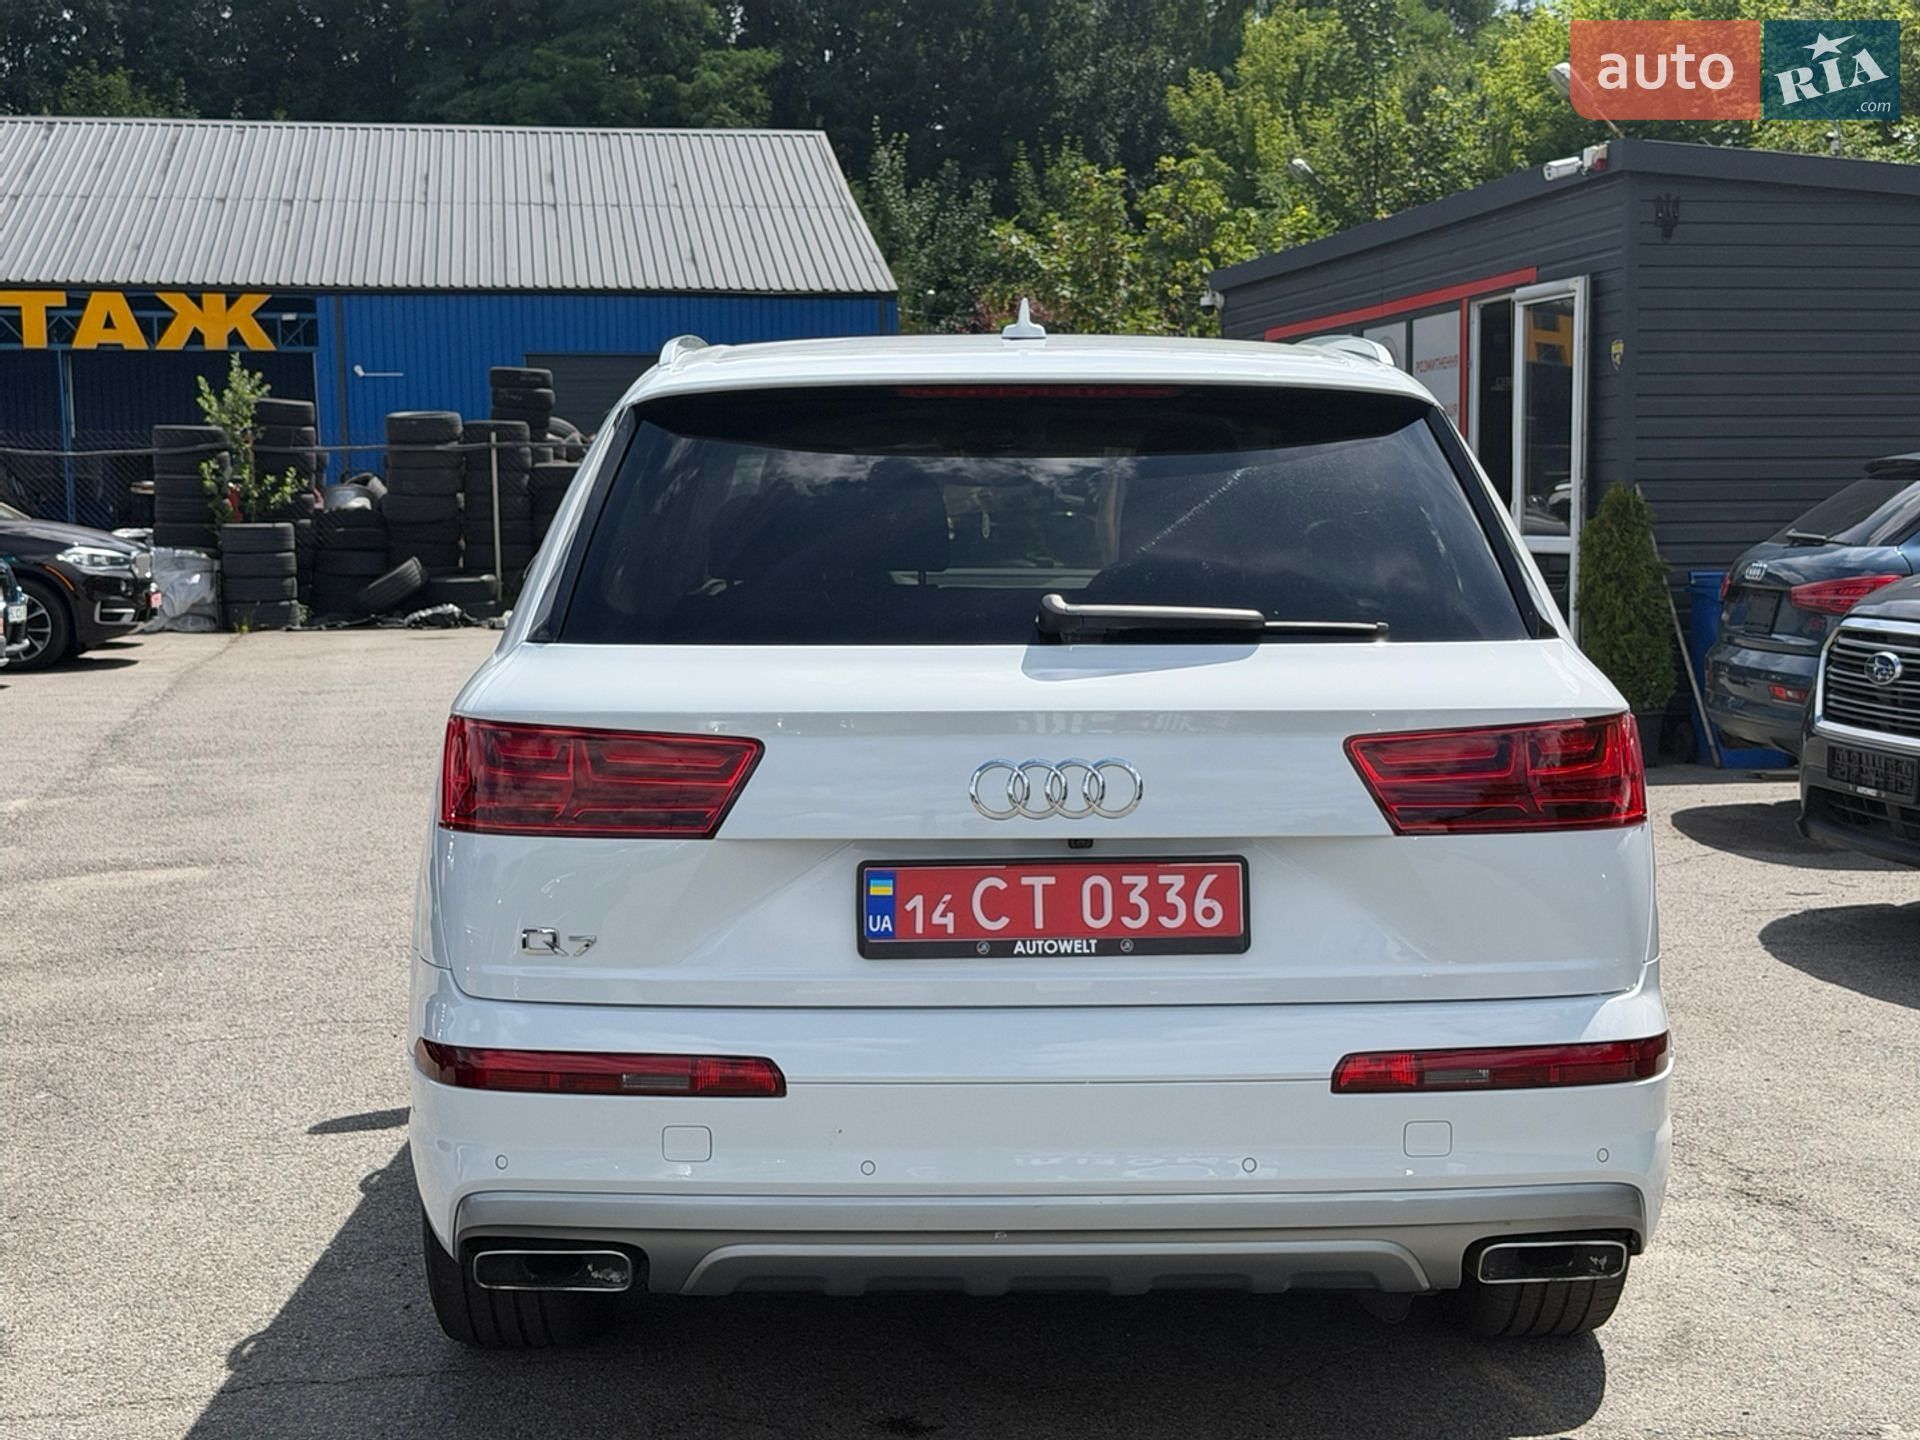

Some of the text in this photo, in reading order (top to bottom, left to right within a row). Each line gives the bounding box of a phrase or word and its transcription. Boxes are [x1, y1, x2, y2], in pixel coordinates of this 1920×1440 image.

[0, 291, 277, 351] ТАЖ
[904, 873, 1224, 934] 14 CT 0336
[868, 914, 893, 932] UA
[522, 927, 597, 957] Q7
[1013, 939, 1097, 955] AUTOWELT
